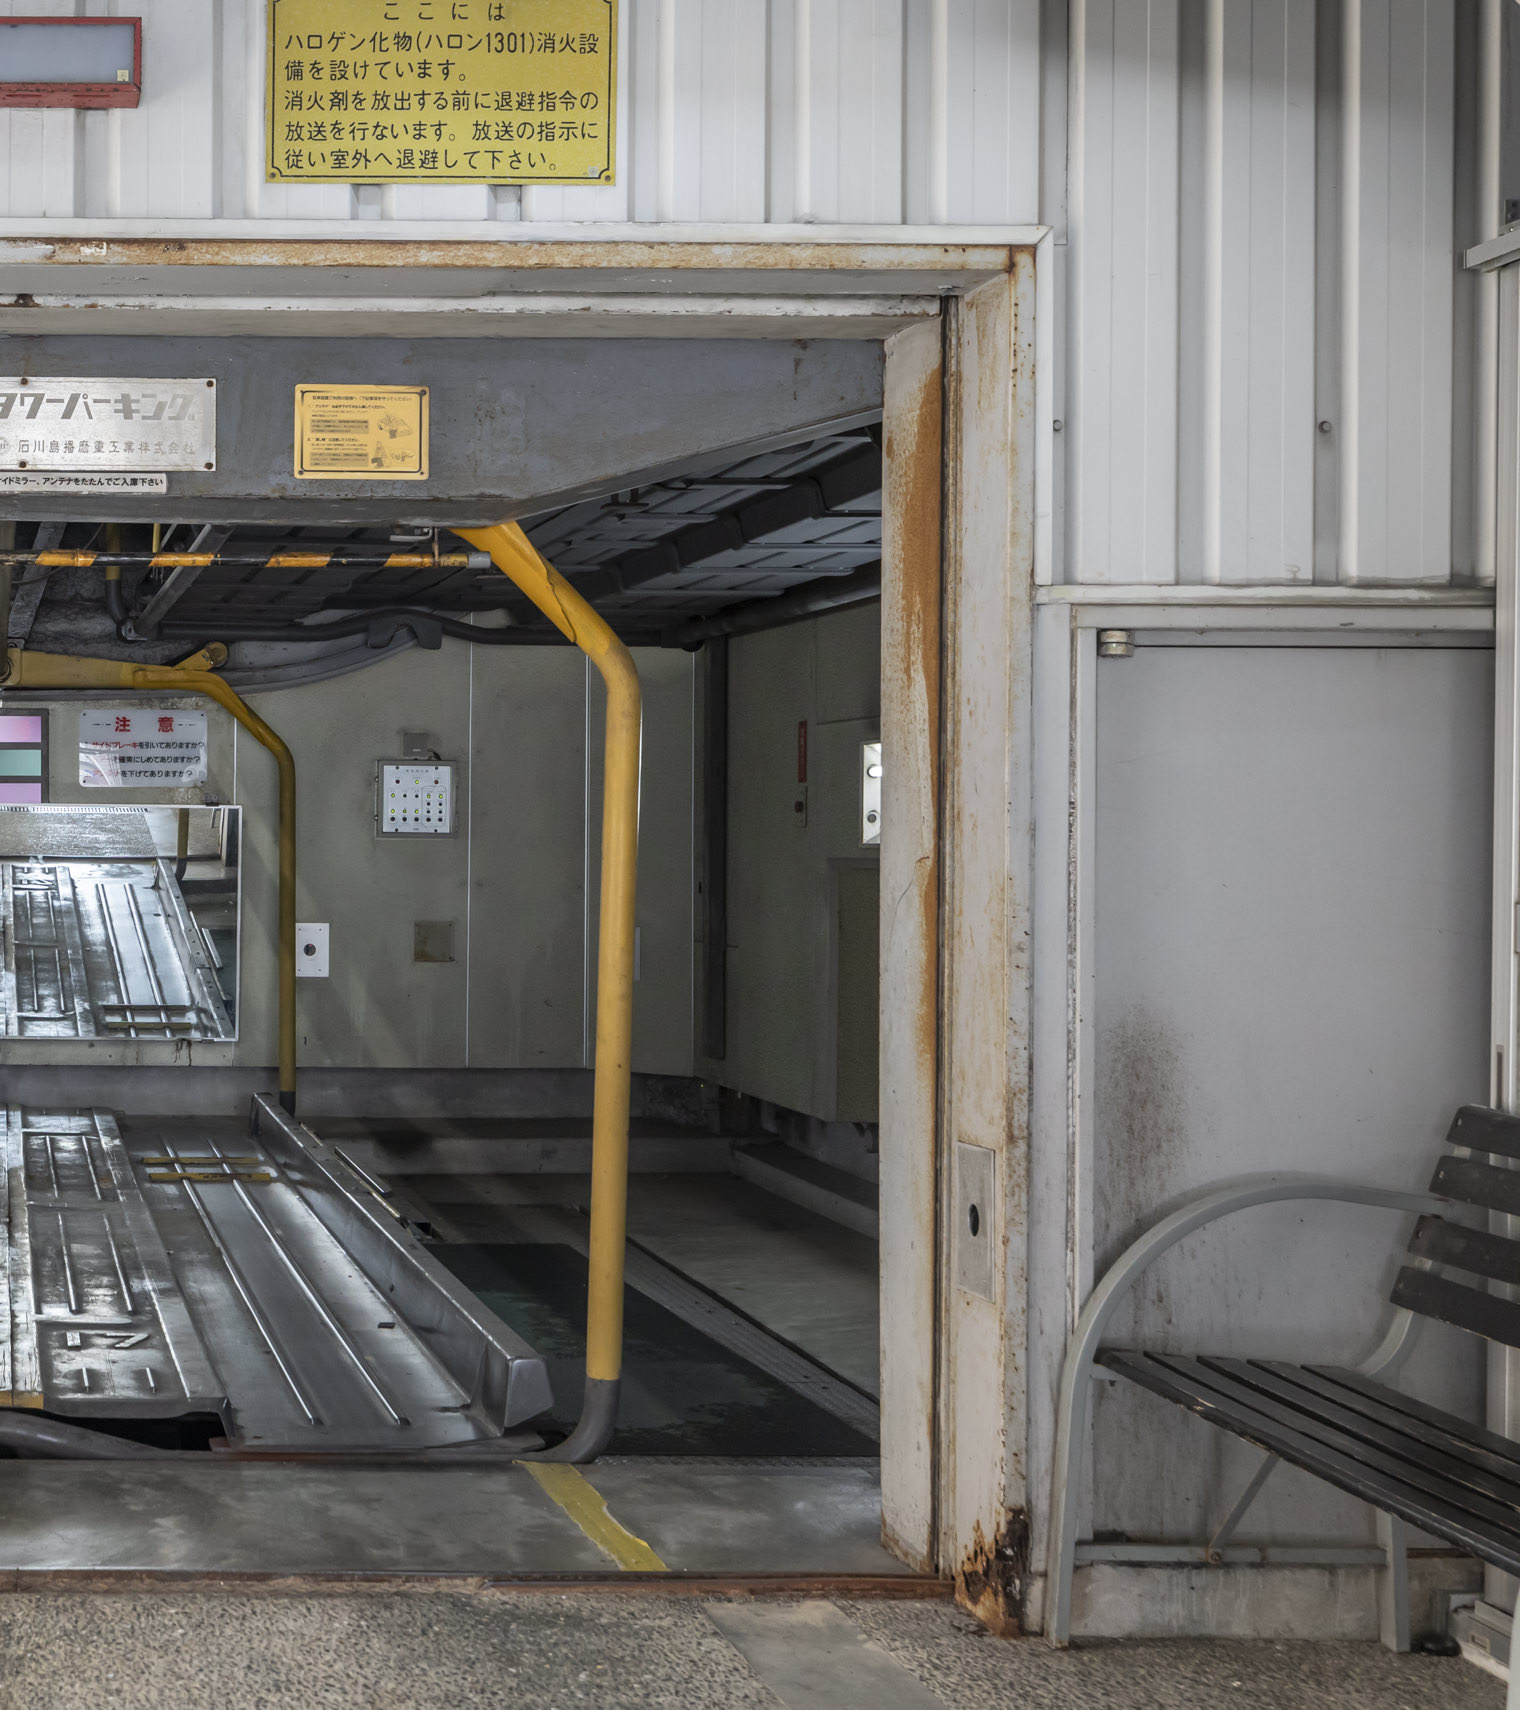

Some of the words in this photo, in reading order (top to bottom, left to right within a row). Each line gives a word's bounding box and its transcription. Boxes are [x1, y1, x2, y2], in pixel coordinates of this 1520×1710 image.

[383, 2, 506, 22] ここには
[285, 31, 599, 54] ハロゲン化物(ハロン1301)消火設
[284, 59, 467, 82] 備を設けています。
[284, 90, 599, 112] 消火剤を放出する前に退避指令の
[284, 148, 557, 172] 従い室外へ退避して下さい。
[17, 439, 196, 455] 石川島播磨重工業株式会社
